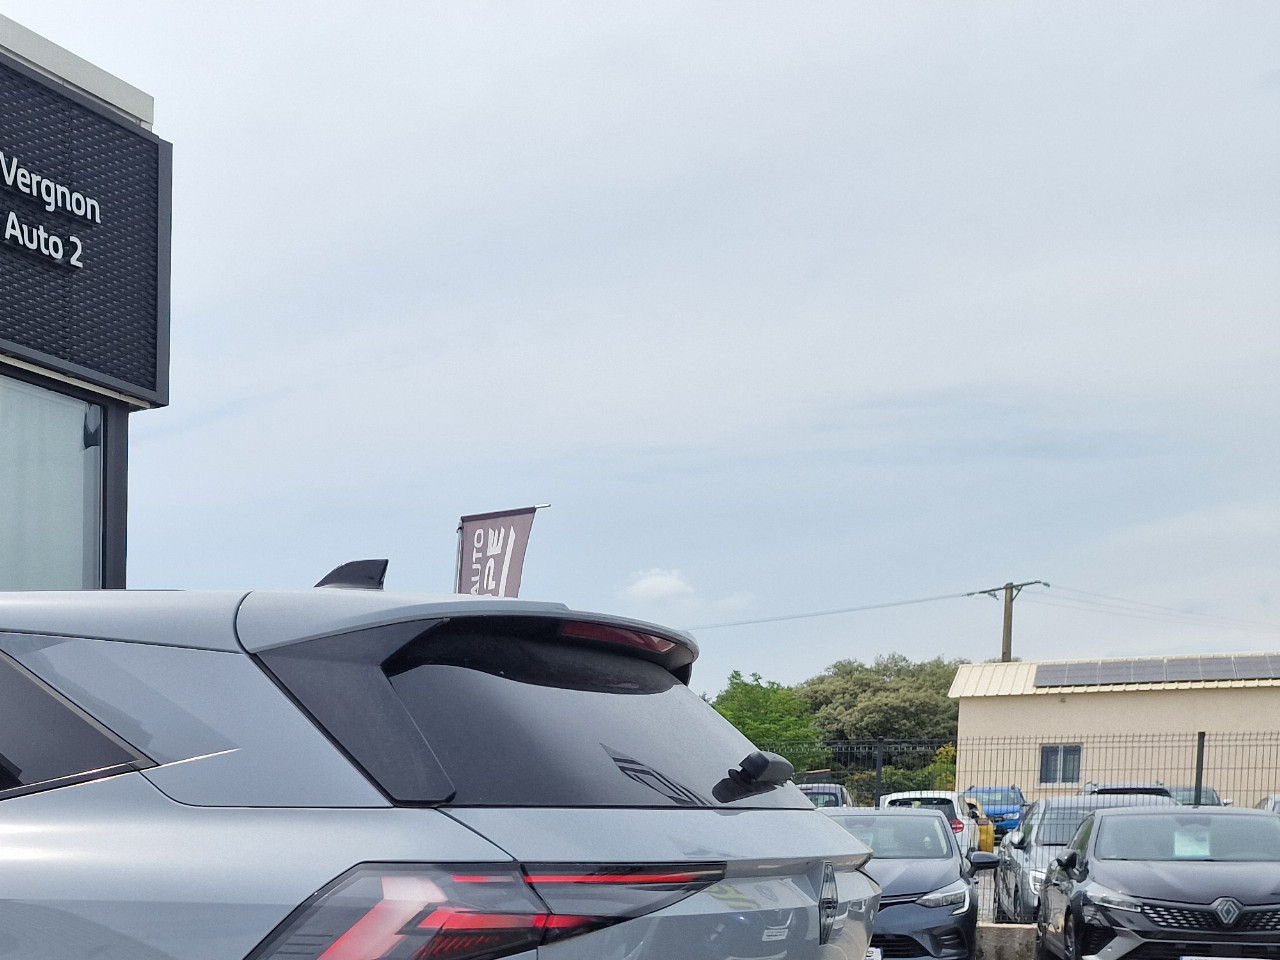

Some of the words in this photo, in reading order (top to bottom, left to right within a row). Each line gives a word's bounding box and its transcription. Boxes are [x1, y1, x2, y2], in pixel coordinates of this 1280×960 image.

[4, 211, 64, 260] Auto
[69, 236, 84, 268] 2
[470, 528, 484, 595] AUTO
